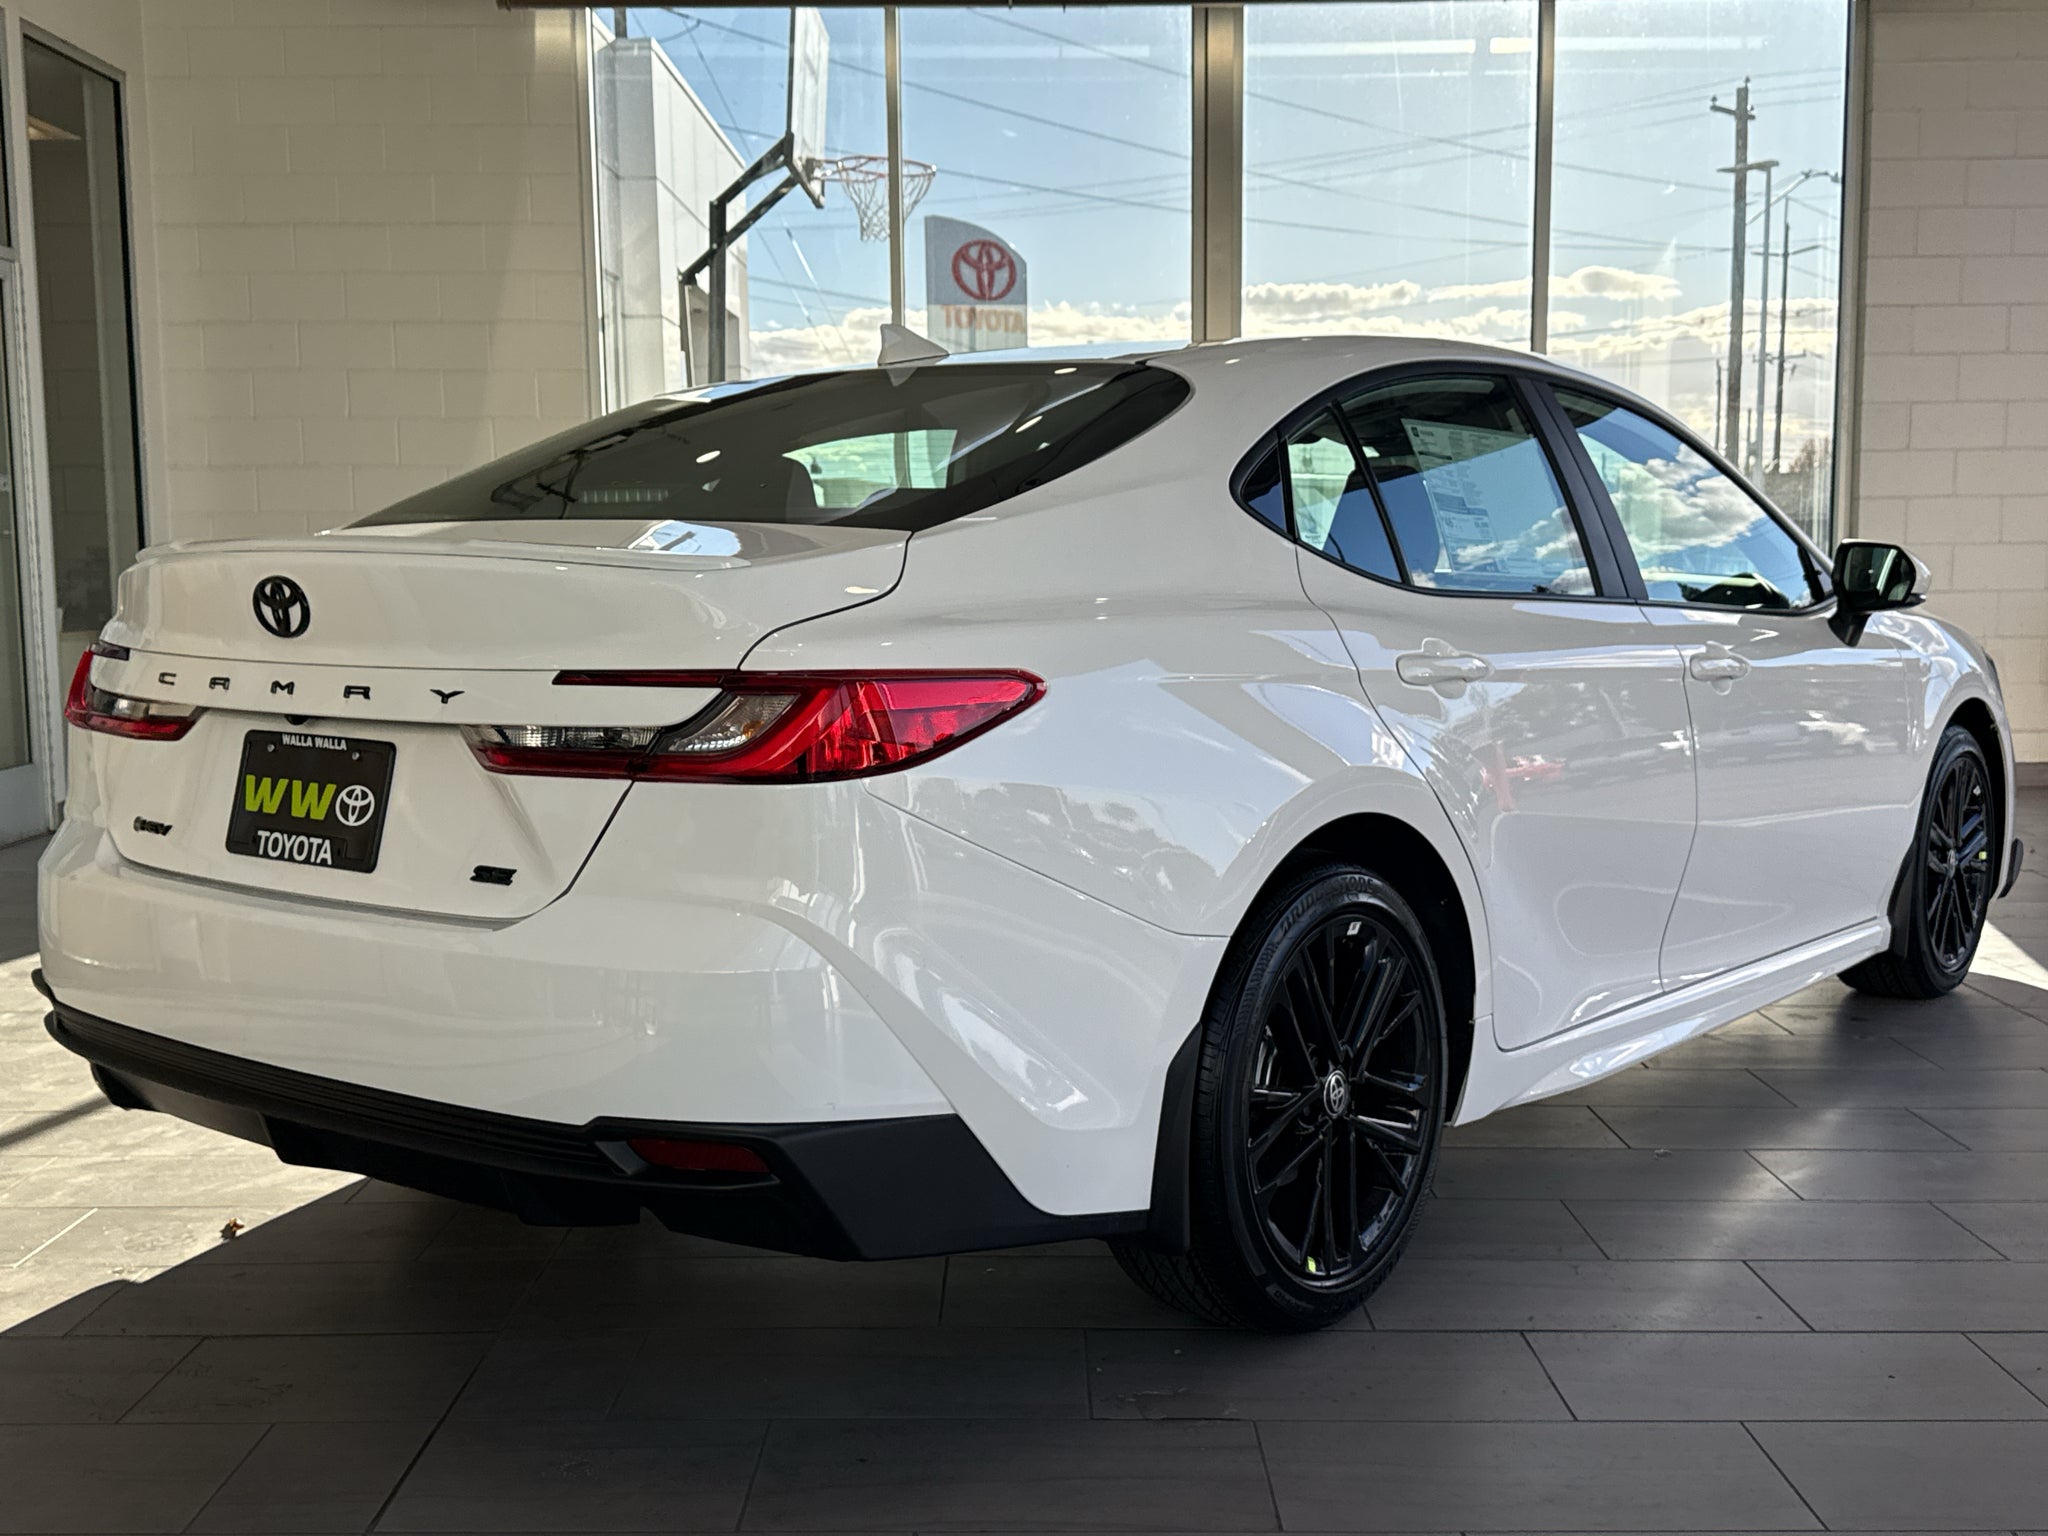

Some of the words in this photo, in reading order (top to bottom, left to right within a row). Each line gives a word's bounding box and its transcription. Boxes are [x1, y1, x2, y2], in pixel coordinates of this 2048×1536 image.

[942, 305, 1025, 332] TOYOTA
[158, 672, 465, 704] CAMRY
[282, 733, 312, 747] WALLA
[315, 736, 346, 750] WALLA
[245, 774, 337, 821] WW
[257, 830, 332, 865] TOYOTA
